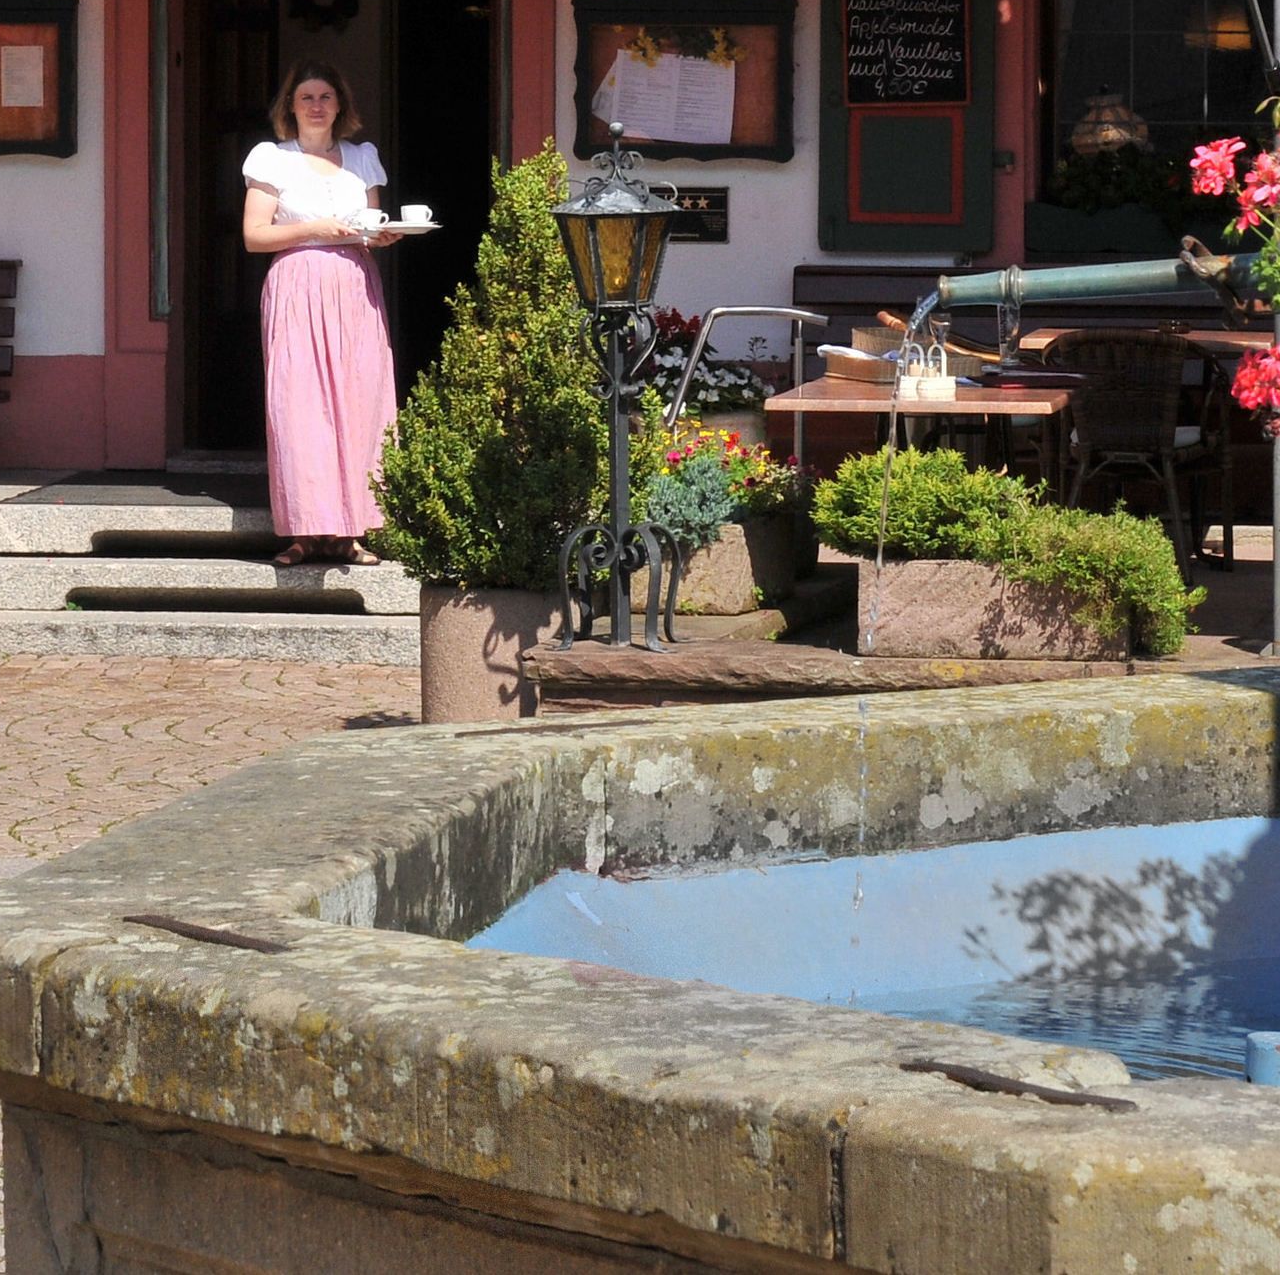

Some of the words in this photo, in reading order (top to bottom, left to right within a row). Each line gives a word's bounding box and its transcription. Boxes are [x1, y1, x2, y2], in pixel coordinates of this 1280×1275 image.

[849, 16, 955, 40] Apfelstrudel
[848, 38, 886, 58] mit
[848, 58, 887, 76] und
[892, 59, 956, 79] Sahne
